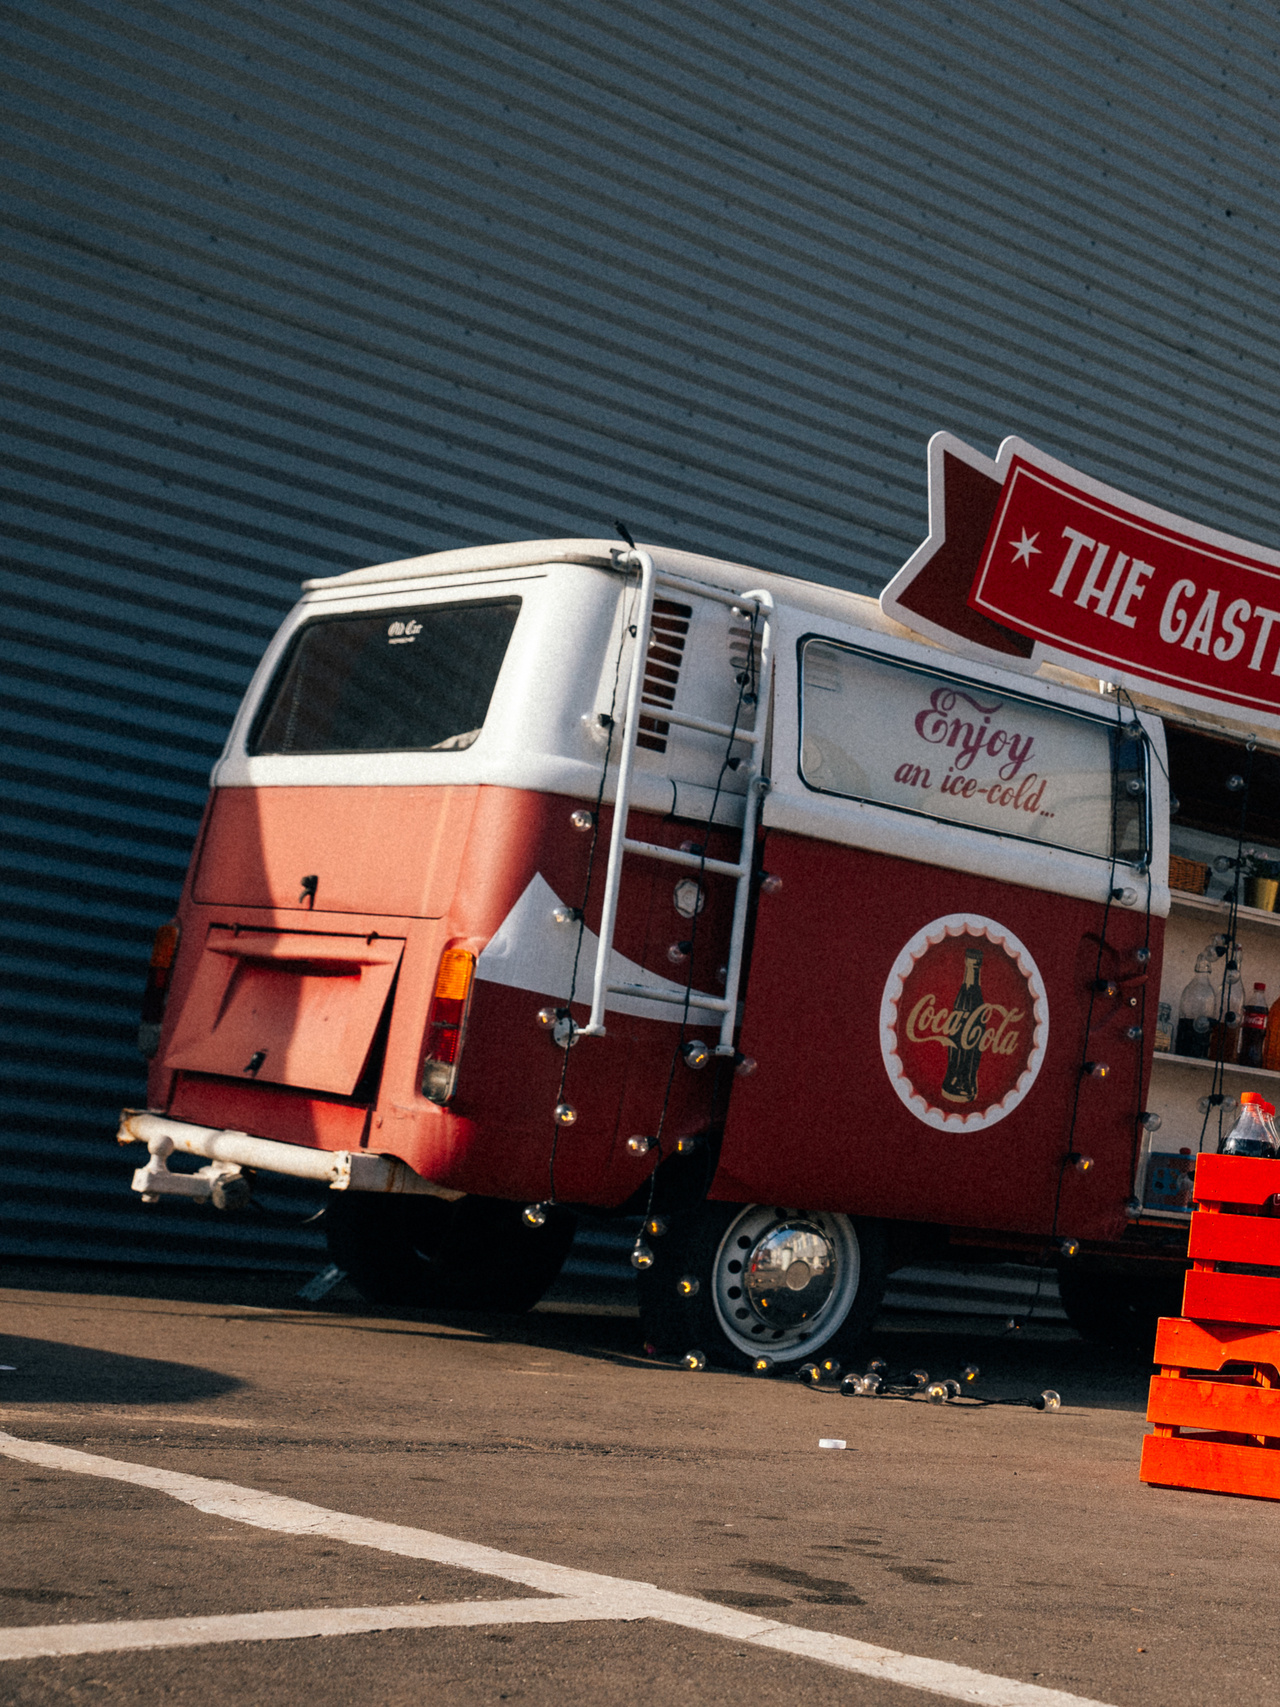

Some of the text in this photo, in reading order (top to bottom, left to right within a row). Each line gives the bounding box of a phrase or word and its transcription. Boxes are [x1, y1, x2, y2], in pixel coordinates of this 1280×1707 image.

[1049, 526, 1156, 628] THE
[915, 687, 1035, 781] Enjoy
[894, 762, 932, 789] an
[906, 994, 1025, 1055] Coca-Cola
